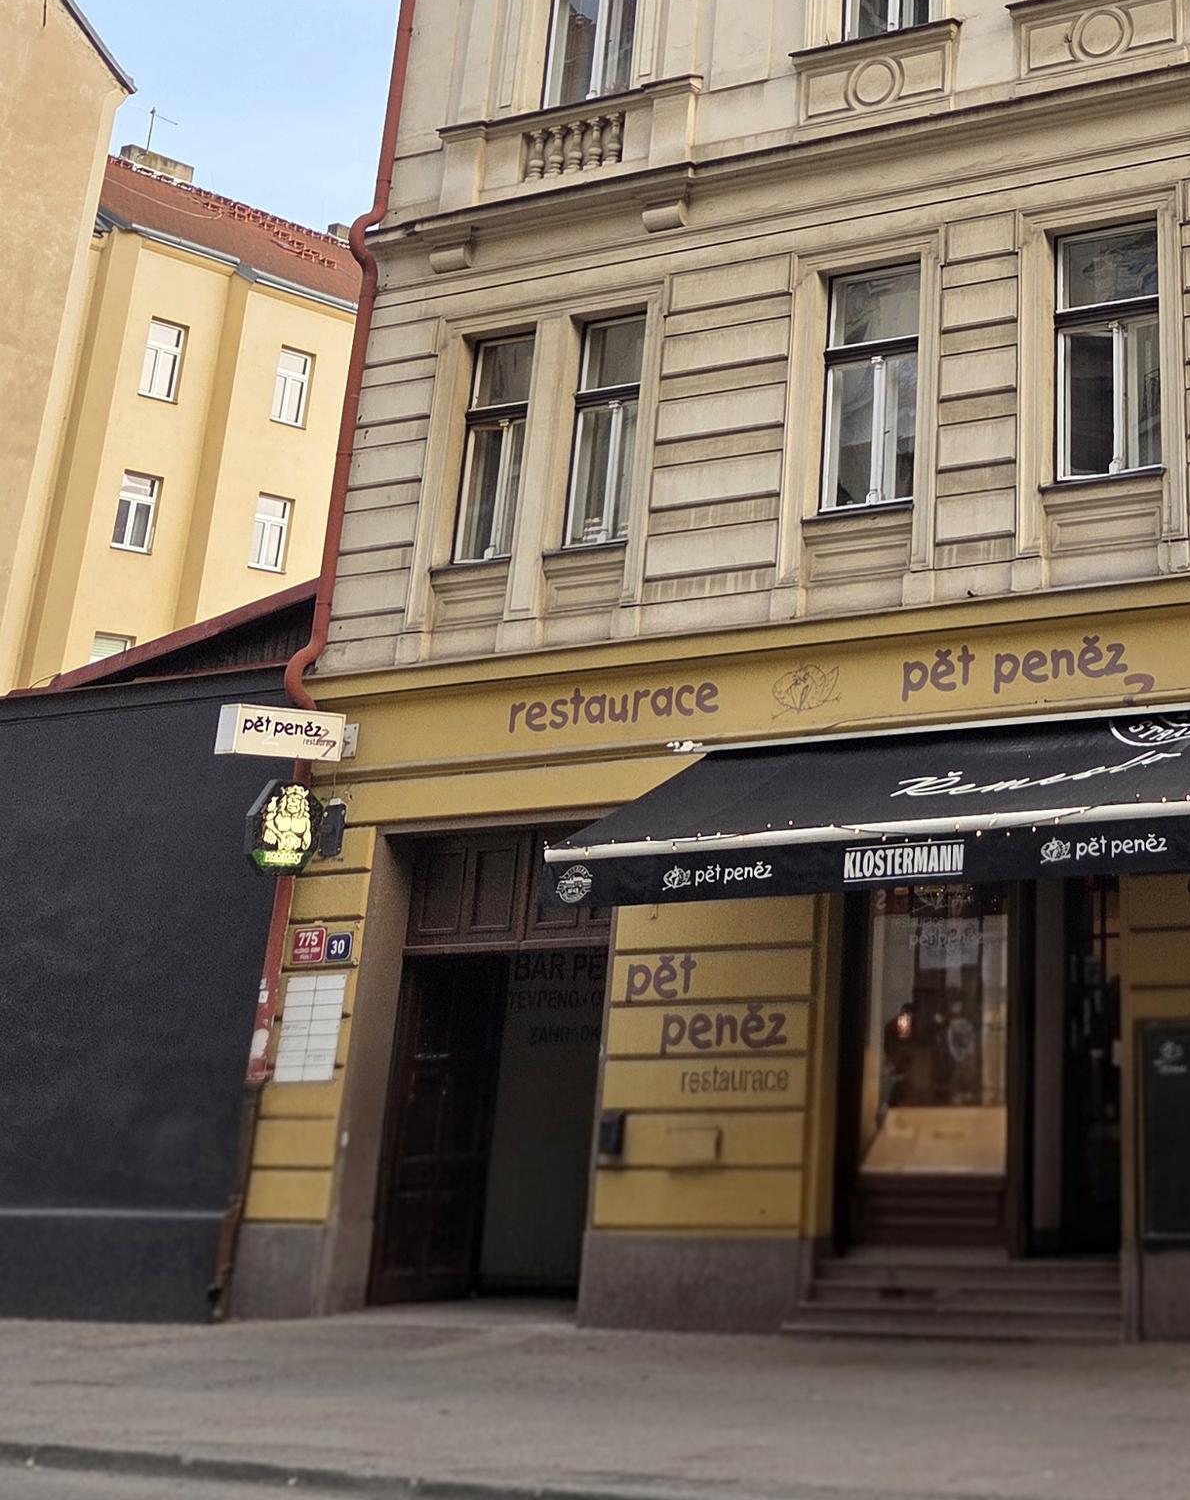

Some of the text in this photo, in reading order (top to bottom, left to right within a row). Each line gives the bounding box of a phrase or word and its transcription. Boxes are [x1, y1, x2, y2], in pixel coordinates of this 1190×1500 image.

[902, 635, 1129, 702] pět peněz
[508, 682, 720, 734] restaurace
[242, 716, 322, 737] pět peněz
[843, 843, 965, 879] KLOSTERMANN
[1076, 834, 1168, 860] pět peněz
[694, 861, 773, 886] pět peněz
[298, 931, 320, 947] 775
[330, 939, 345, 955] 30
[625, 953, 697, 1003] pět
[660, 1003, 788, 1055] peněz
[681, 1065, 790, 1094] restaurace
